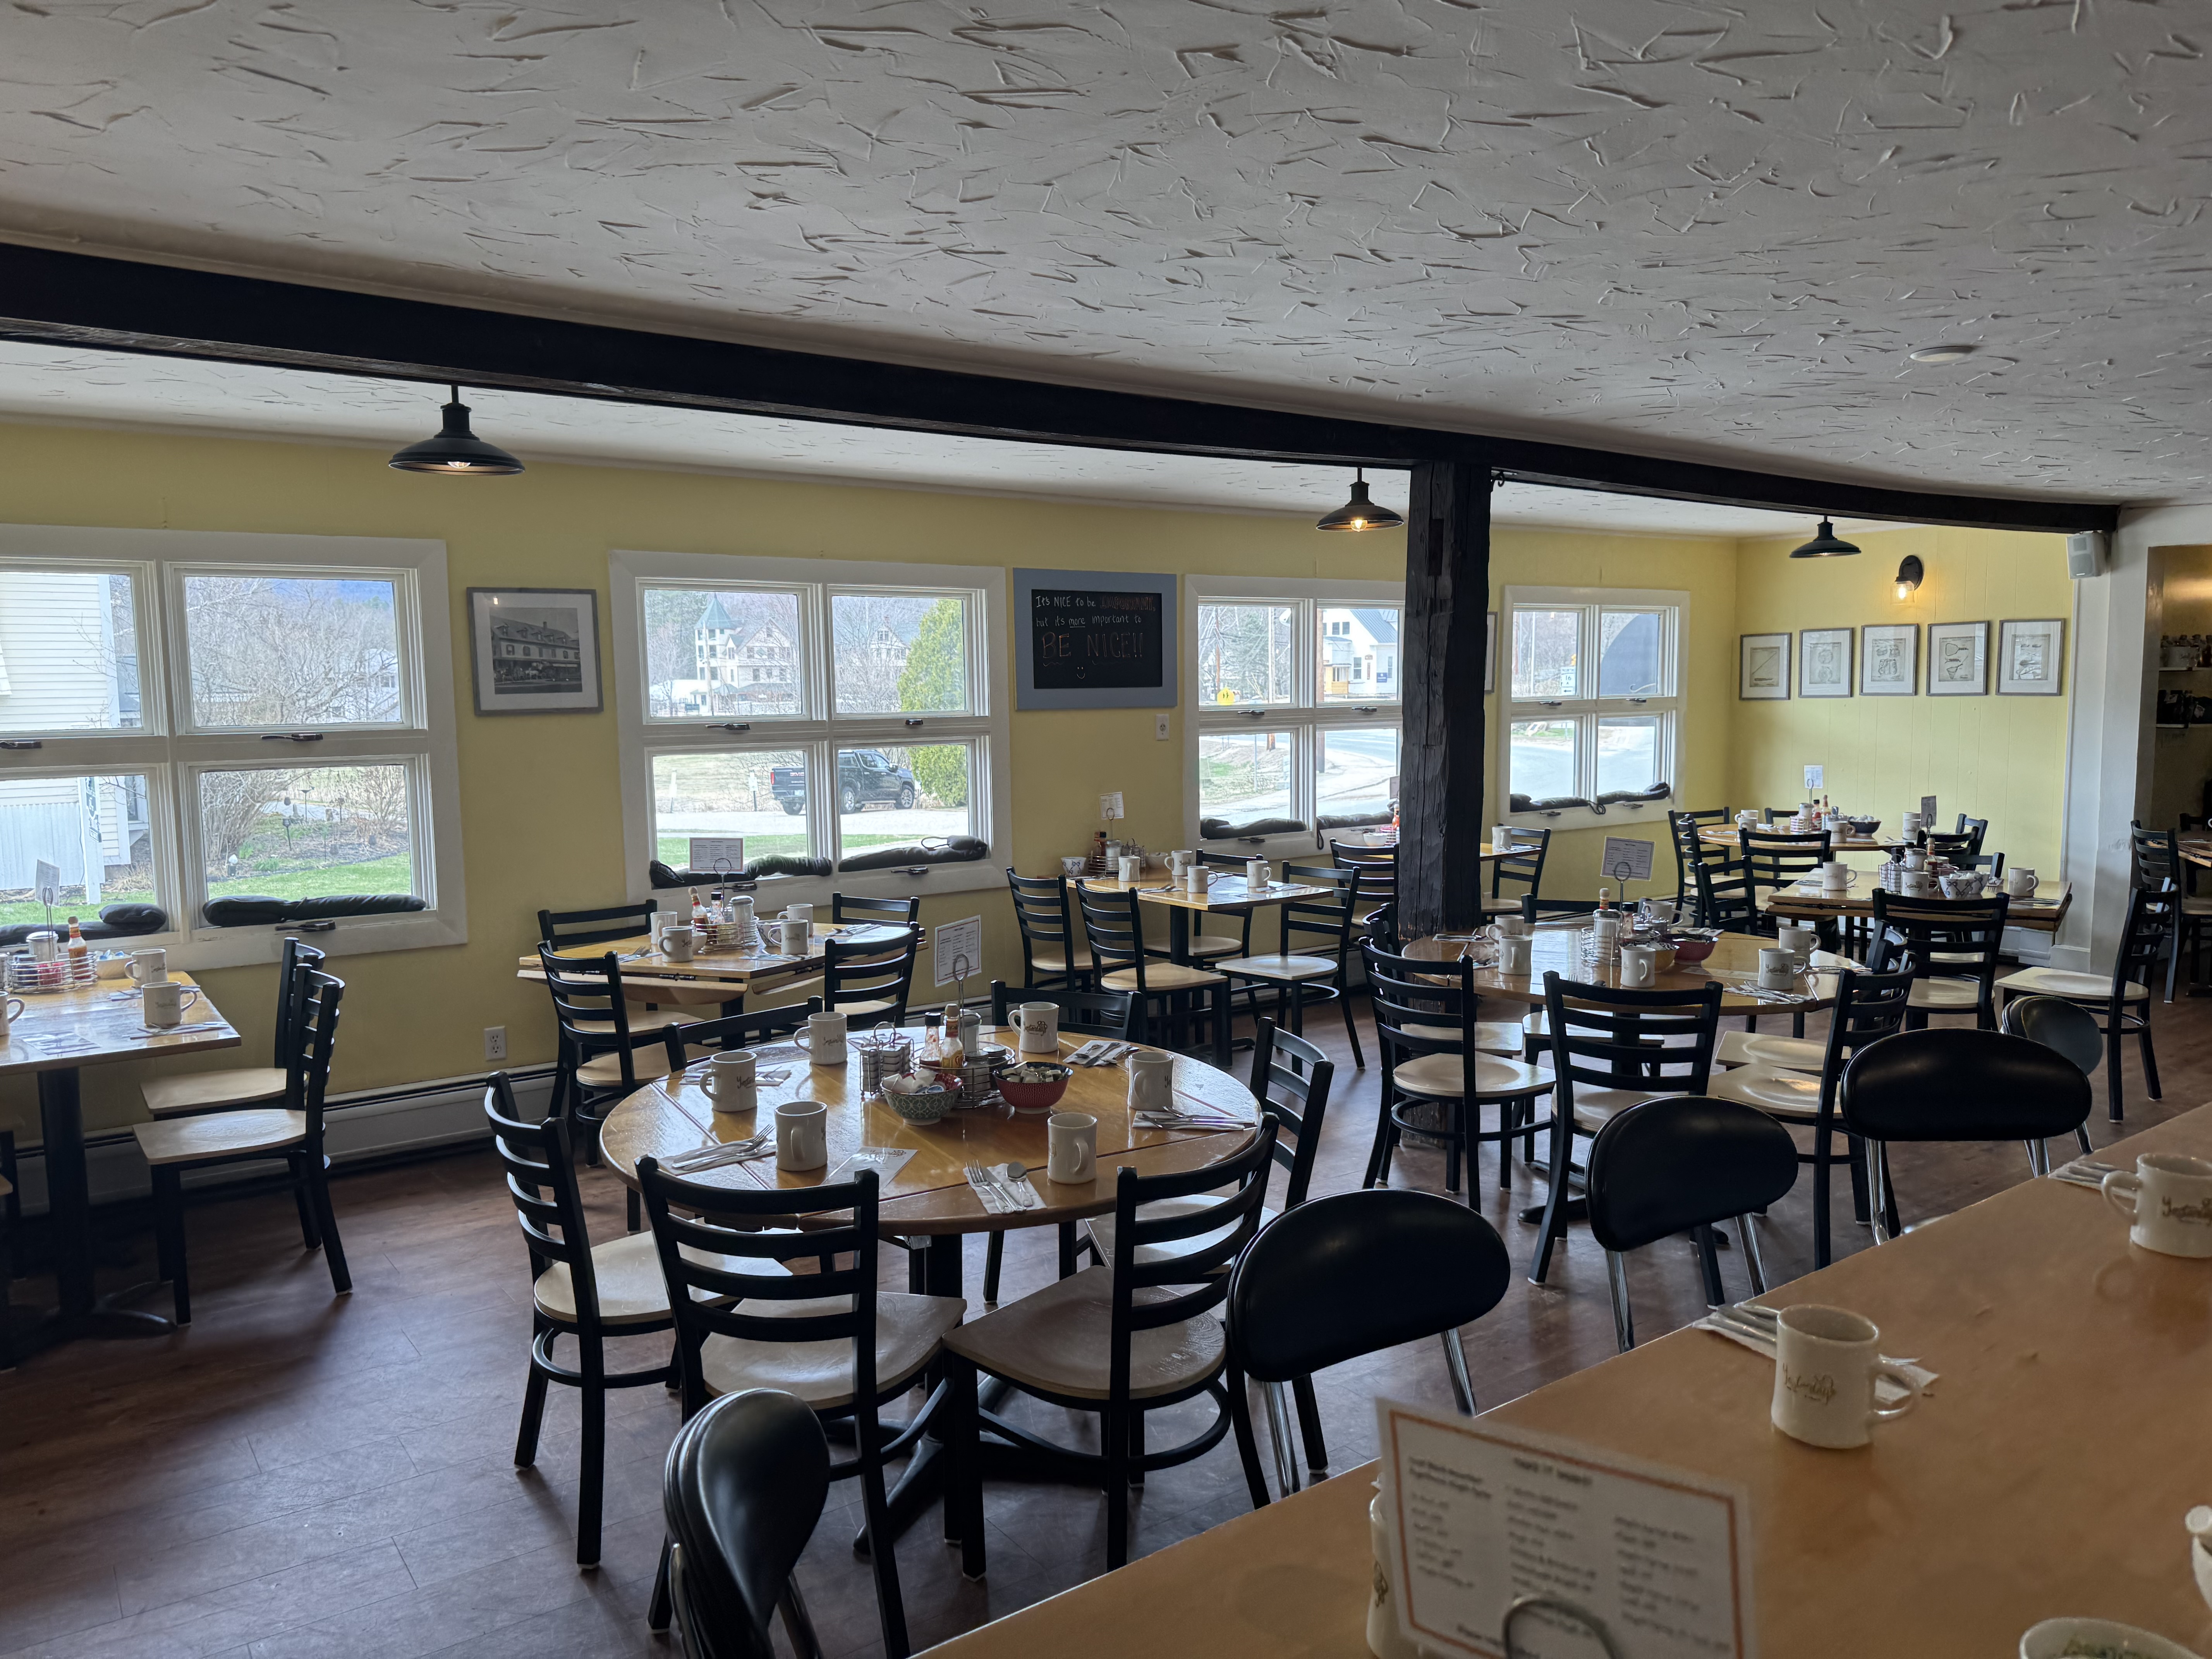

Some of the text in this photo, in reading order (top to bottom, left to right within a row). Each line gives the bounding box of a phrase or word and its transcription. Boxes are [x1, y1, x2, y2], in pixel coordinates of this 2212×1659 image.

[1036, 596, 1050, 607] It's
[1054, 596, 1071, 608] NICE
[1075, 598, 1084, 606] to
[1087, 596, 1096, 606] be
[1036, 617, 1048, 627] but
[1069, 618, 1085, 627] more
[1092, 614, 1129, 626] important
[1134, 613, 1142, 623] to
[1042, 631, 1143, 658] BE NICE!!
